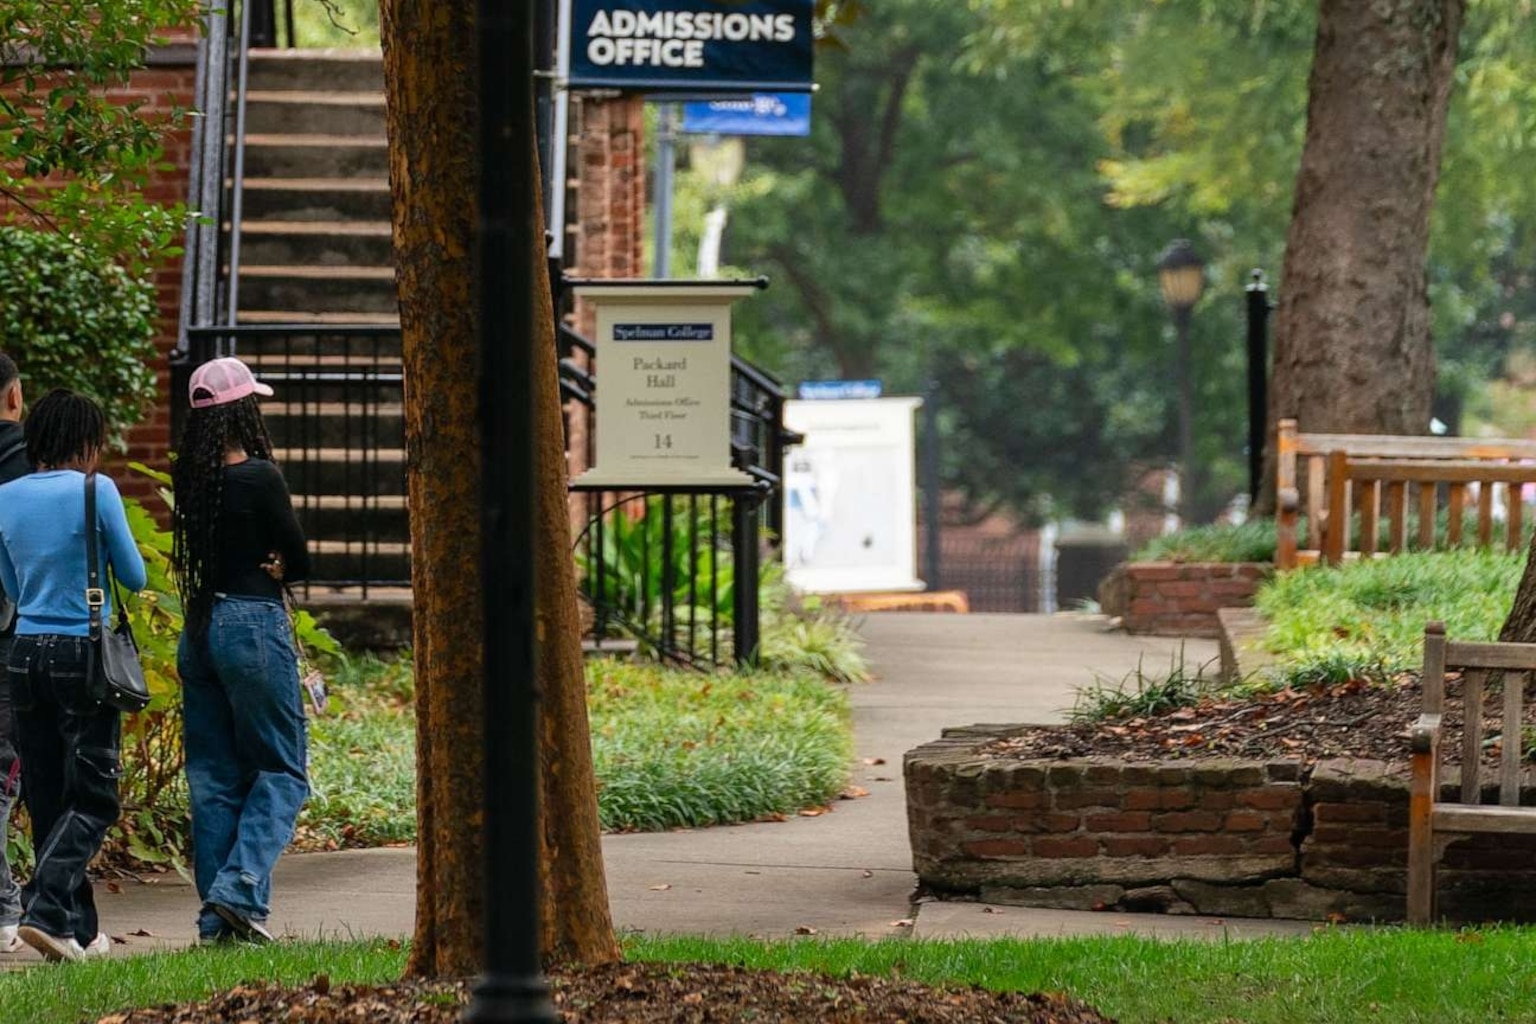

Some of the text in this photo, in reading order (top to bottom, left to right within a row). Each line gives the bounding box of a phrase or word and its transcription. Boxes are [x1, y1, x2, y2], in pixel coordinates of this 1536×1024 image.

[587, 9, 796, 41] ADMISSIONS
[587, 37, 704, 66] OFFICE
[615, 327, 710, 339] Spelman College
[633, 357, 687, 370] Packard
[646, 375, 675, 388] Hall
[654, 434, 672, 449] 14
